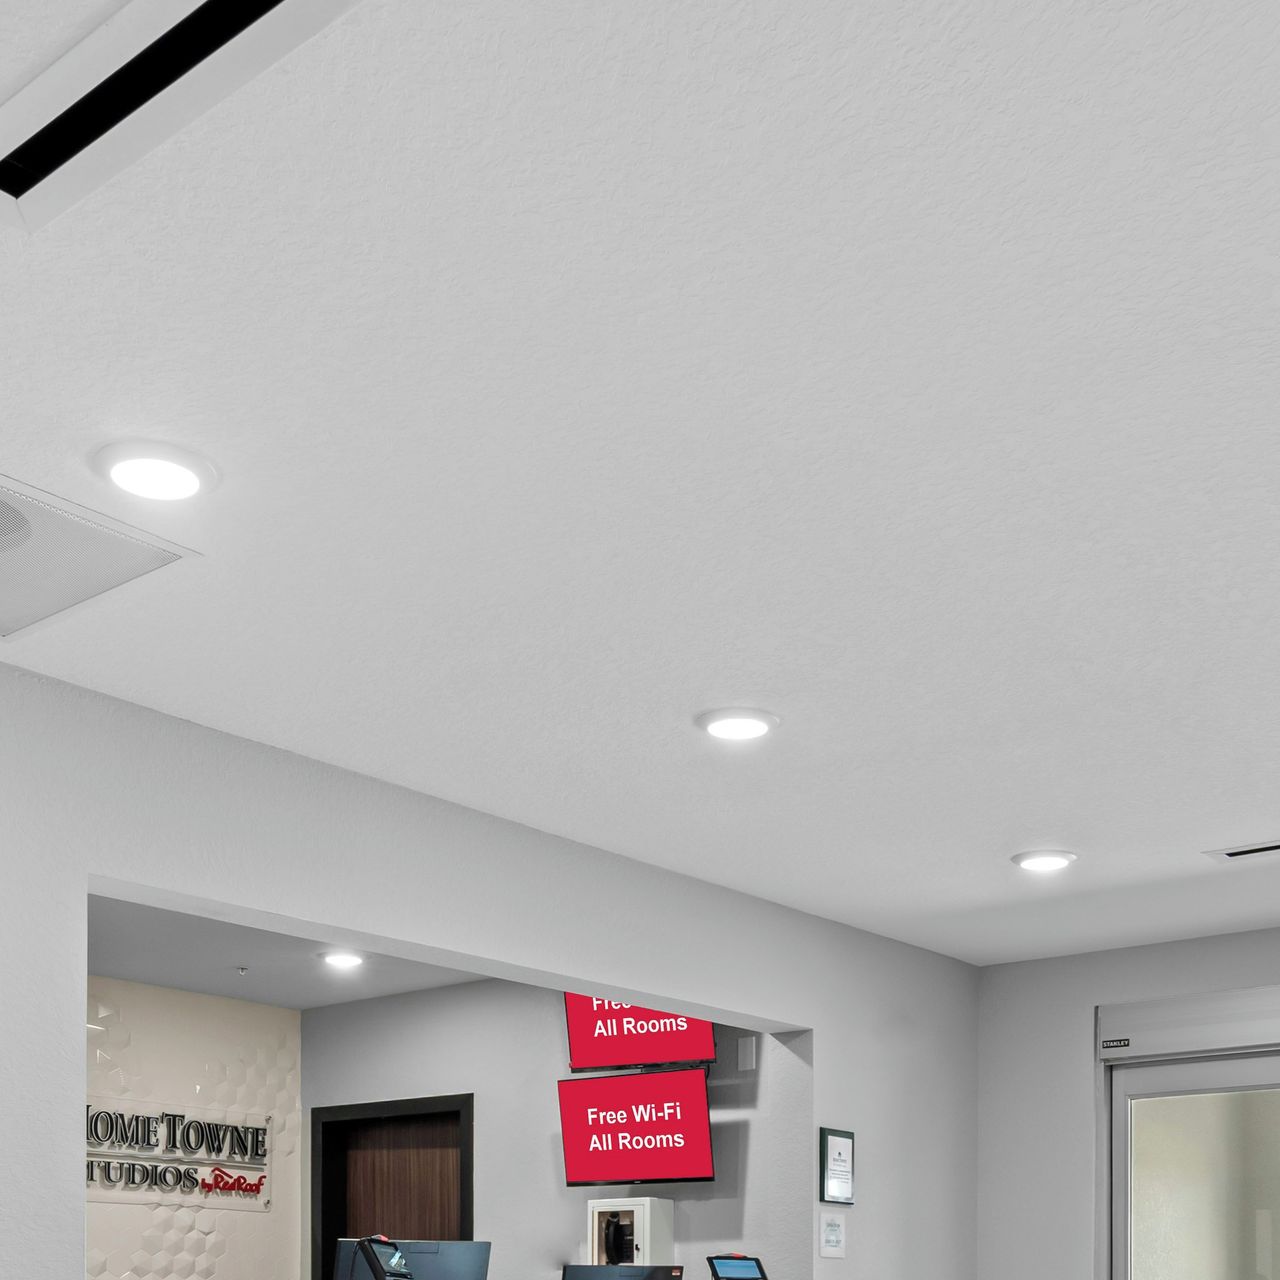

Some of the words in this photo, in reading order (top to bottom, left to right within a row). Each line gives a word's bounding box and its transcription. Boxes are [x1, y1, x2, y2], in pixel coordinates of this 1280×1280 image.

[594, 1019, 618, 1037] All
[623, 1016, 688, 1034] Rooms
[587, 1108, 628, 1125] Free
[632, 1102, 682, 1123] Wi-Fi
[589, 1134, 613, 1151] All
[618, 1132, 685, 1150] Rooms
[86, 1159, 199, 1189] TUDIOS
